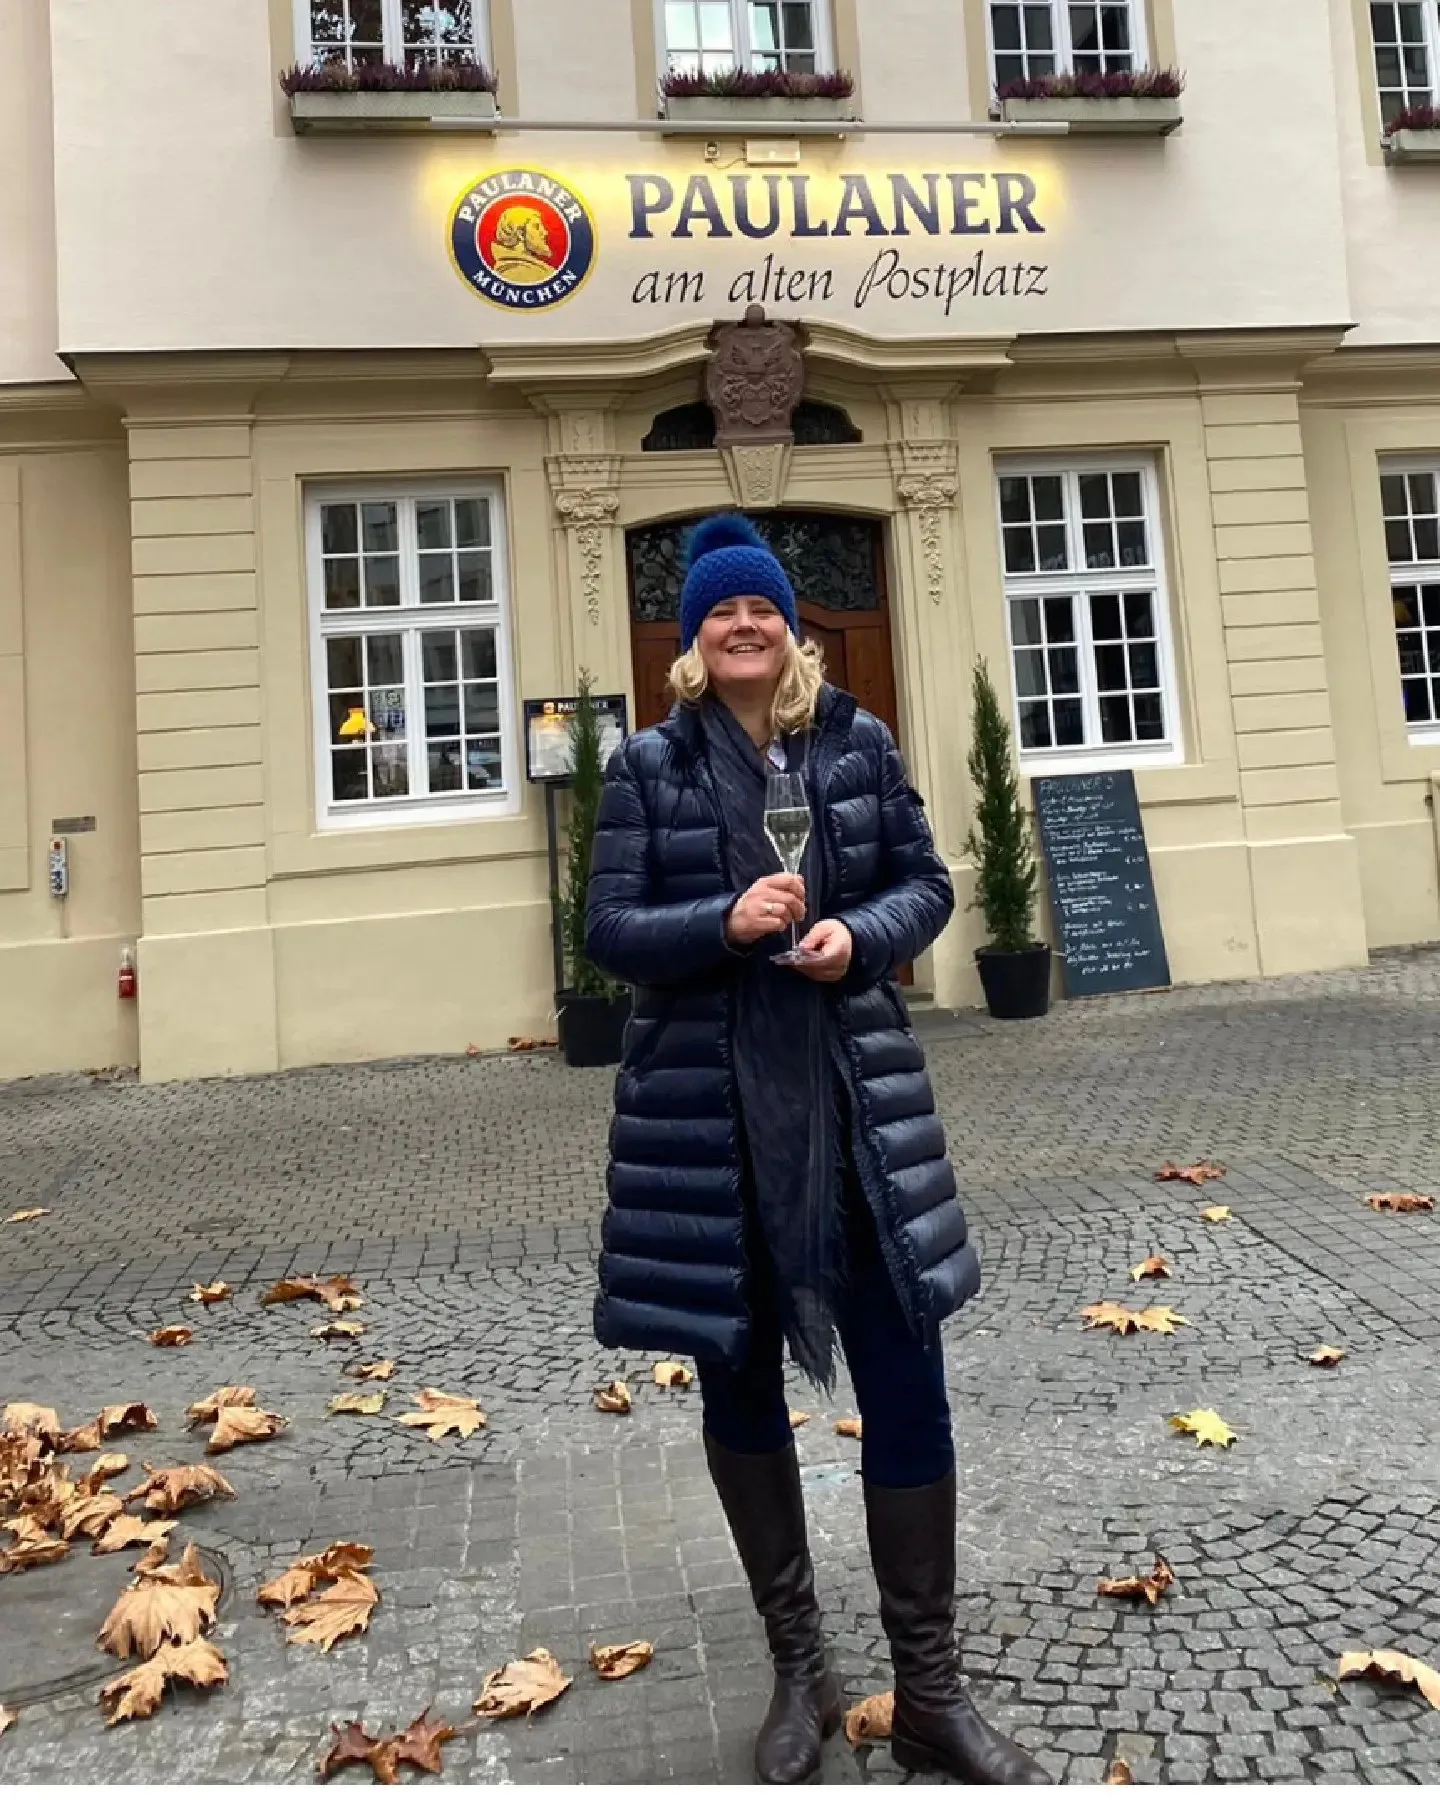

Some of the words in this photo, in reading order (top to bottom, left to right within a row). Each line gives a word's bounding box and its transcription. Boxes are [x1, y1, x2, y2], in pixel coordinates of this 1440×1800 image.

[459, 173, 582, 223] PAULANER
[625, 173, 1046, 238] PAULANER
[472, 269, 577, 304] MÜNCHEN
[631, 271, 705, 304] am
[727, 252, 833, 303] alten
[854, 248, 1048, 316] Postplatz
